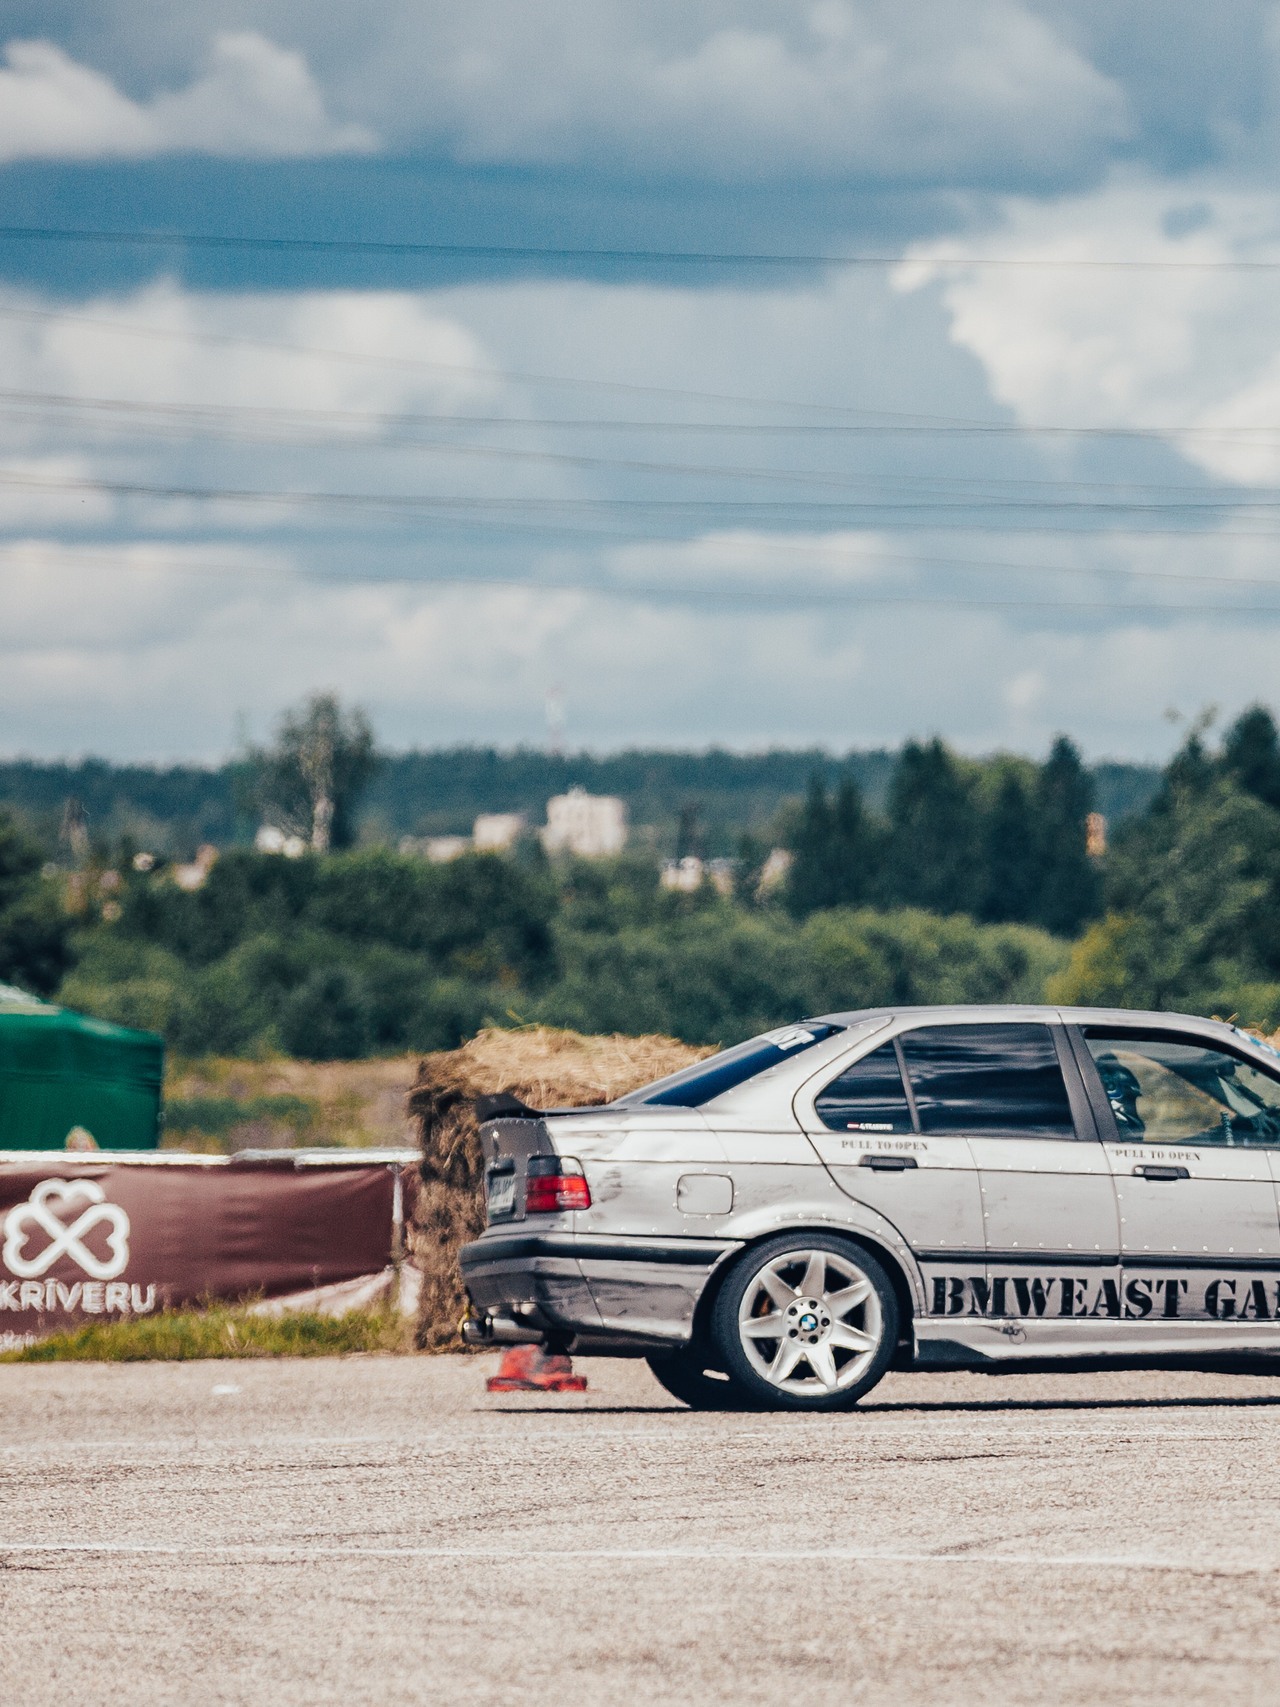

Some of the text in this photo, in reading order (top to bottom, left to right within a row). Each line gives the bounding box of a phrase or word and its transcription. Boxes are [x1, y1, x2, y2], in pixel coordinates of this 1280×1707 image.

[841, 1140, 929, 1151] PULL TO OPEN
[1115, 1149, 1202, 1161] PULL TO OPEN
[929, 1276, 1188, 1318] BMWEAST
